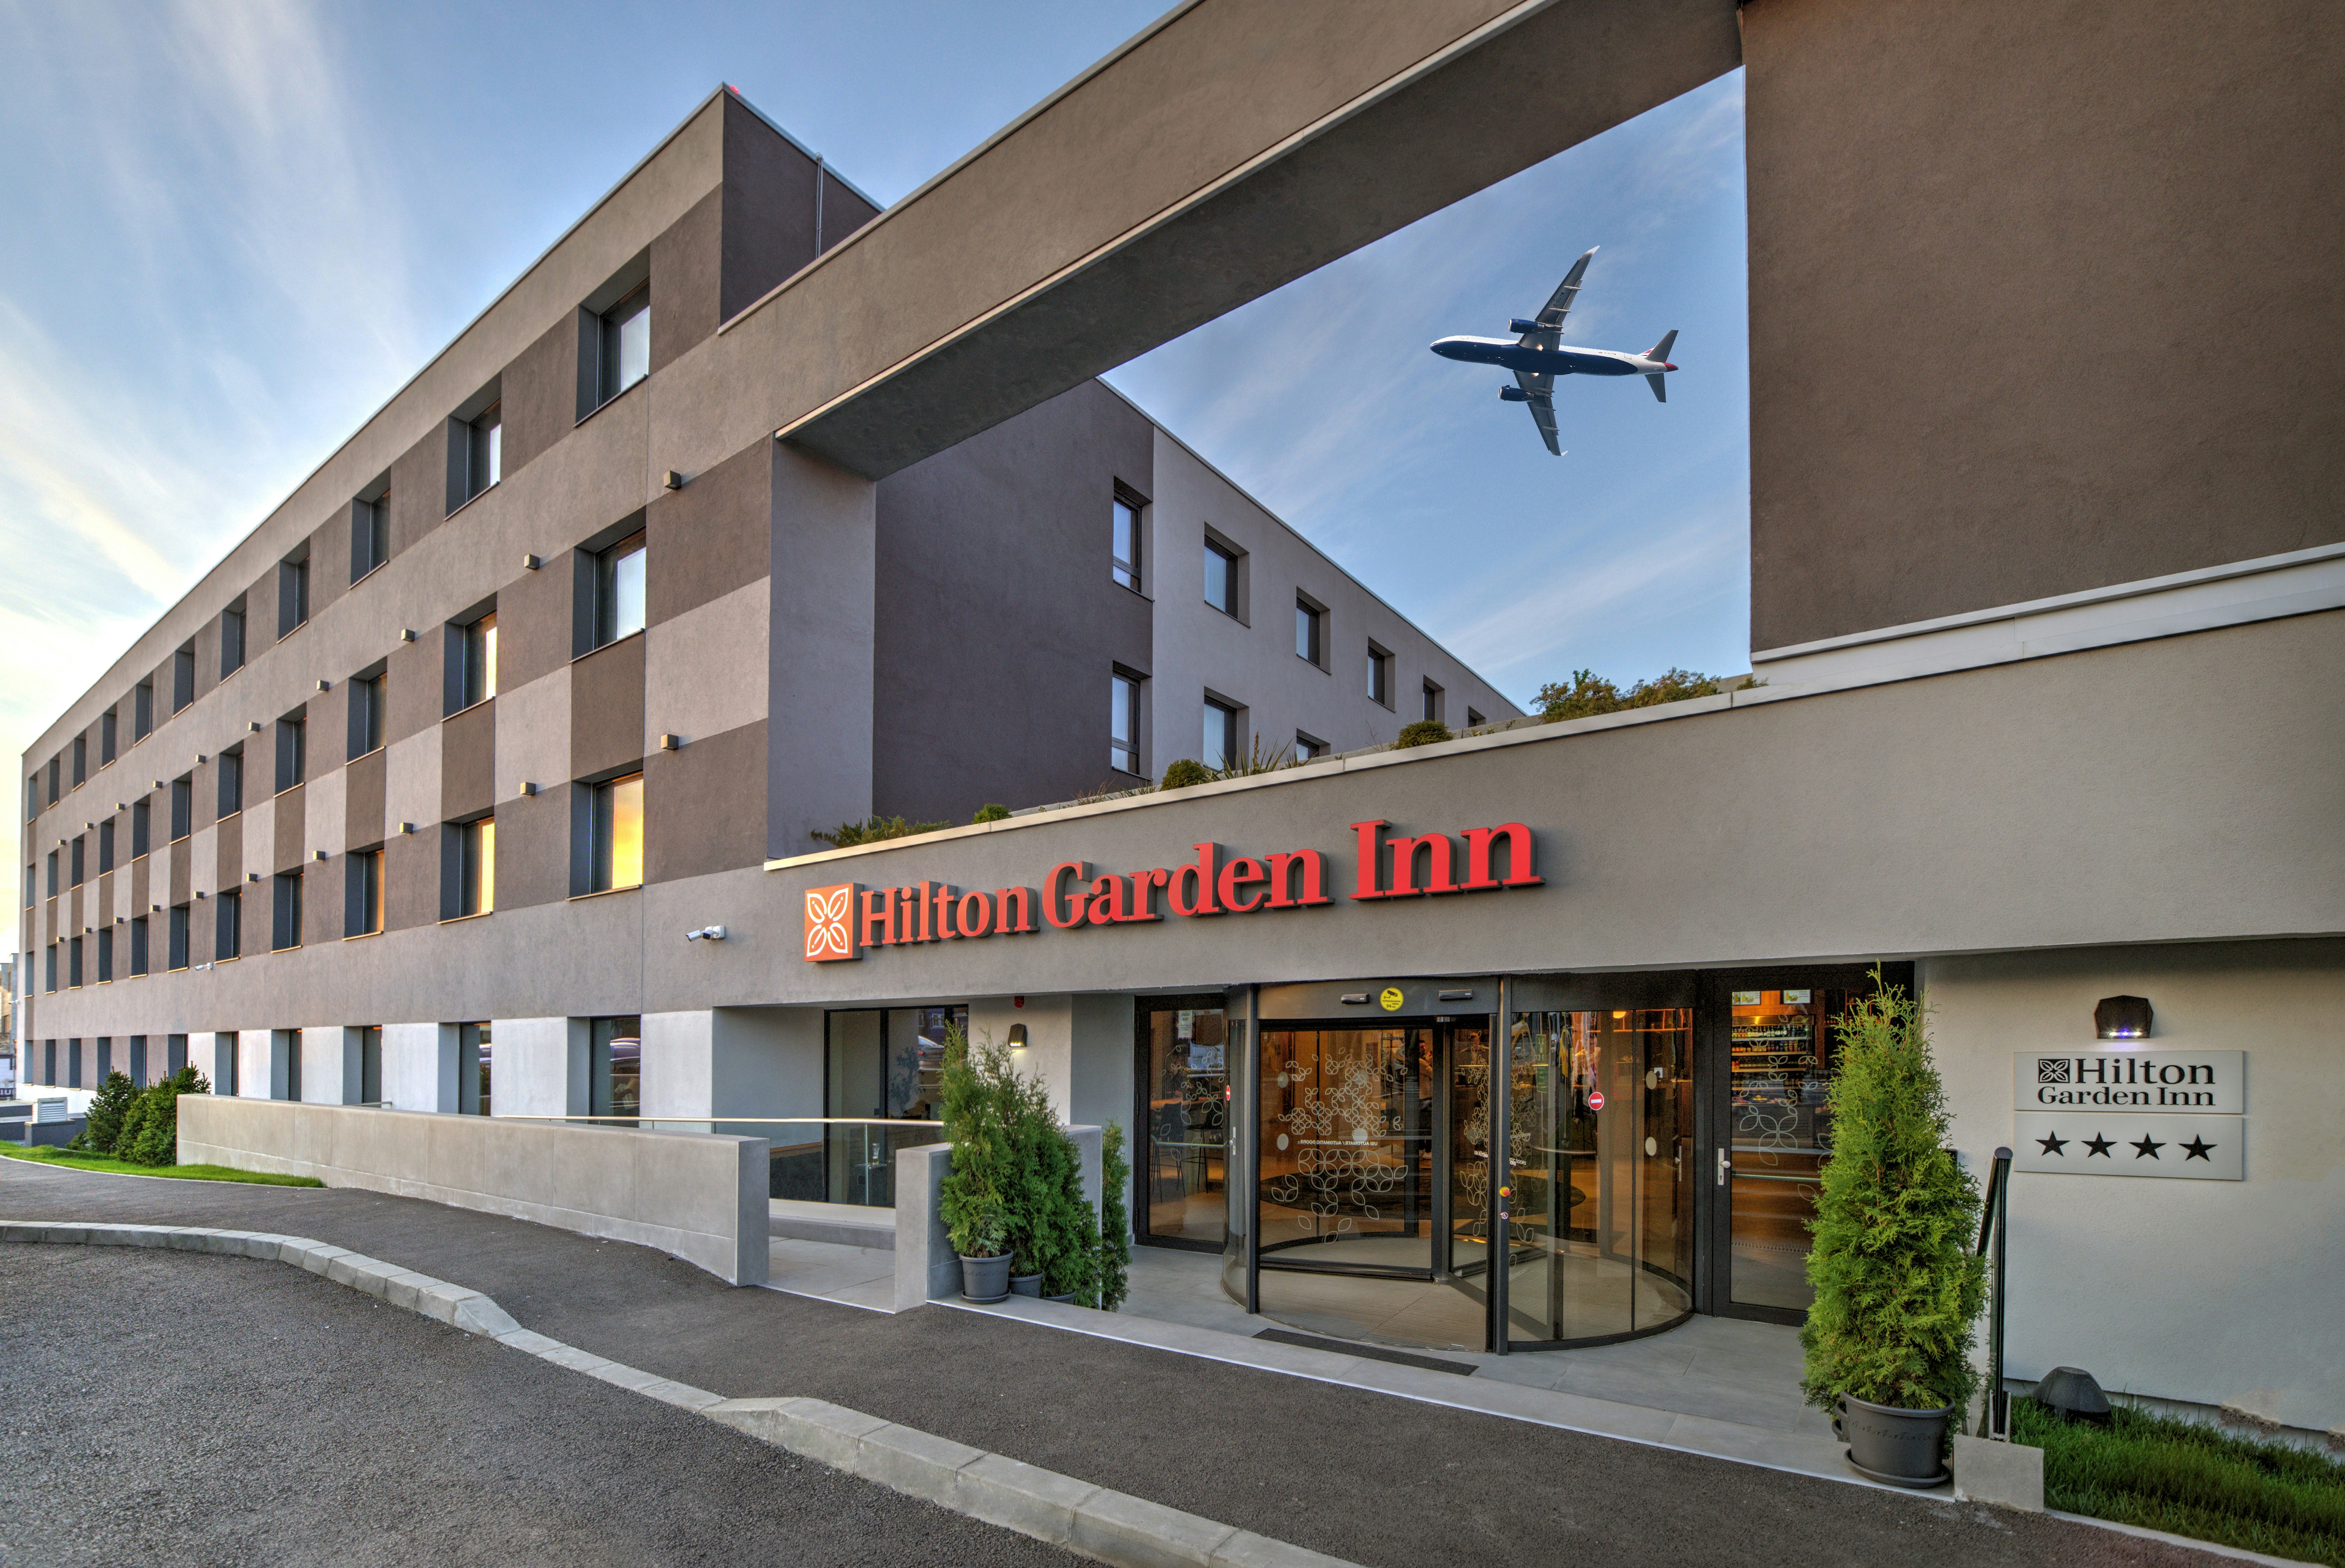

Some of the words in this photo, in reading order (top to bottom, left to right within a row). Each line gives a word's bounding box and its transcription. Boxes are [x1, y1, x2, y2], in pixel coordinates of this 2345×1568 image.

[859, 881, 1036, 947] Hilton
[1042, 842, 1331, 929] Garden
[1350, 819, 1543, 900] Inn
[2075, 1058, 2216, 1084] Hilton
[2037, 1086, 2151, 1105] Garden
[2157, 1087, 2216, 1105] Inn
